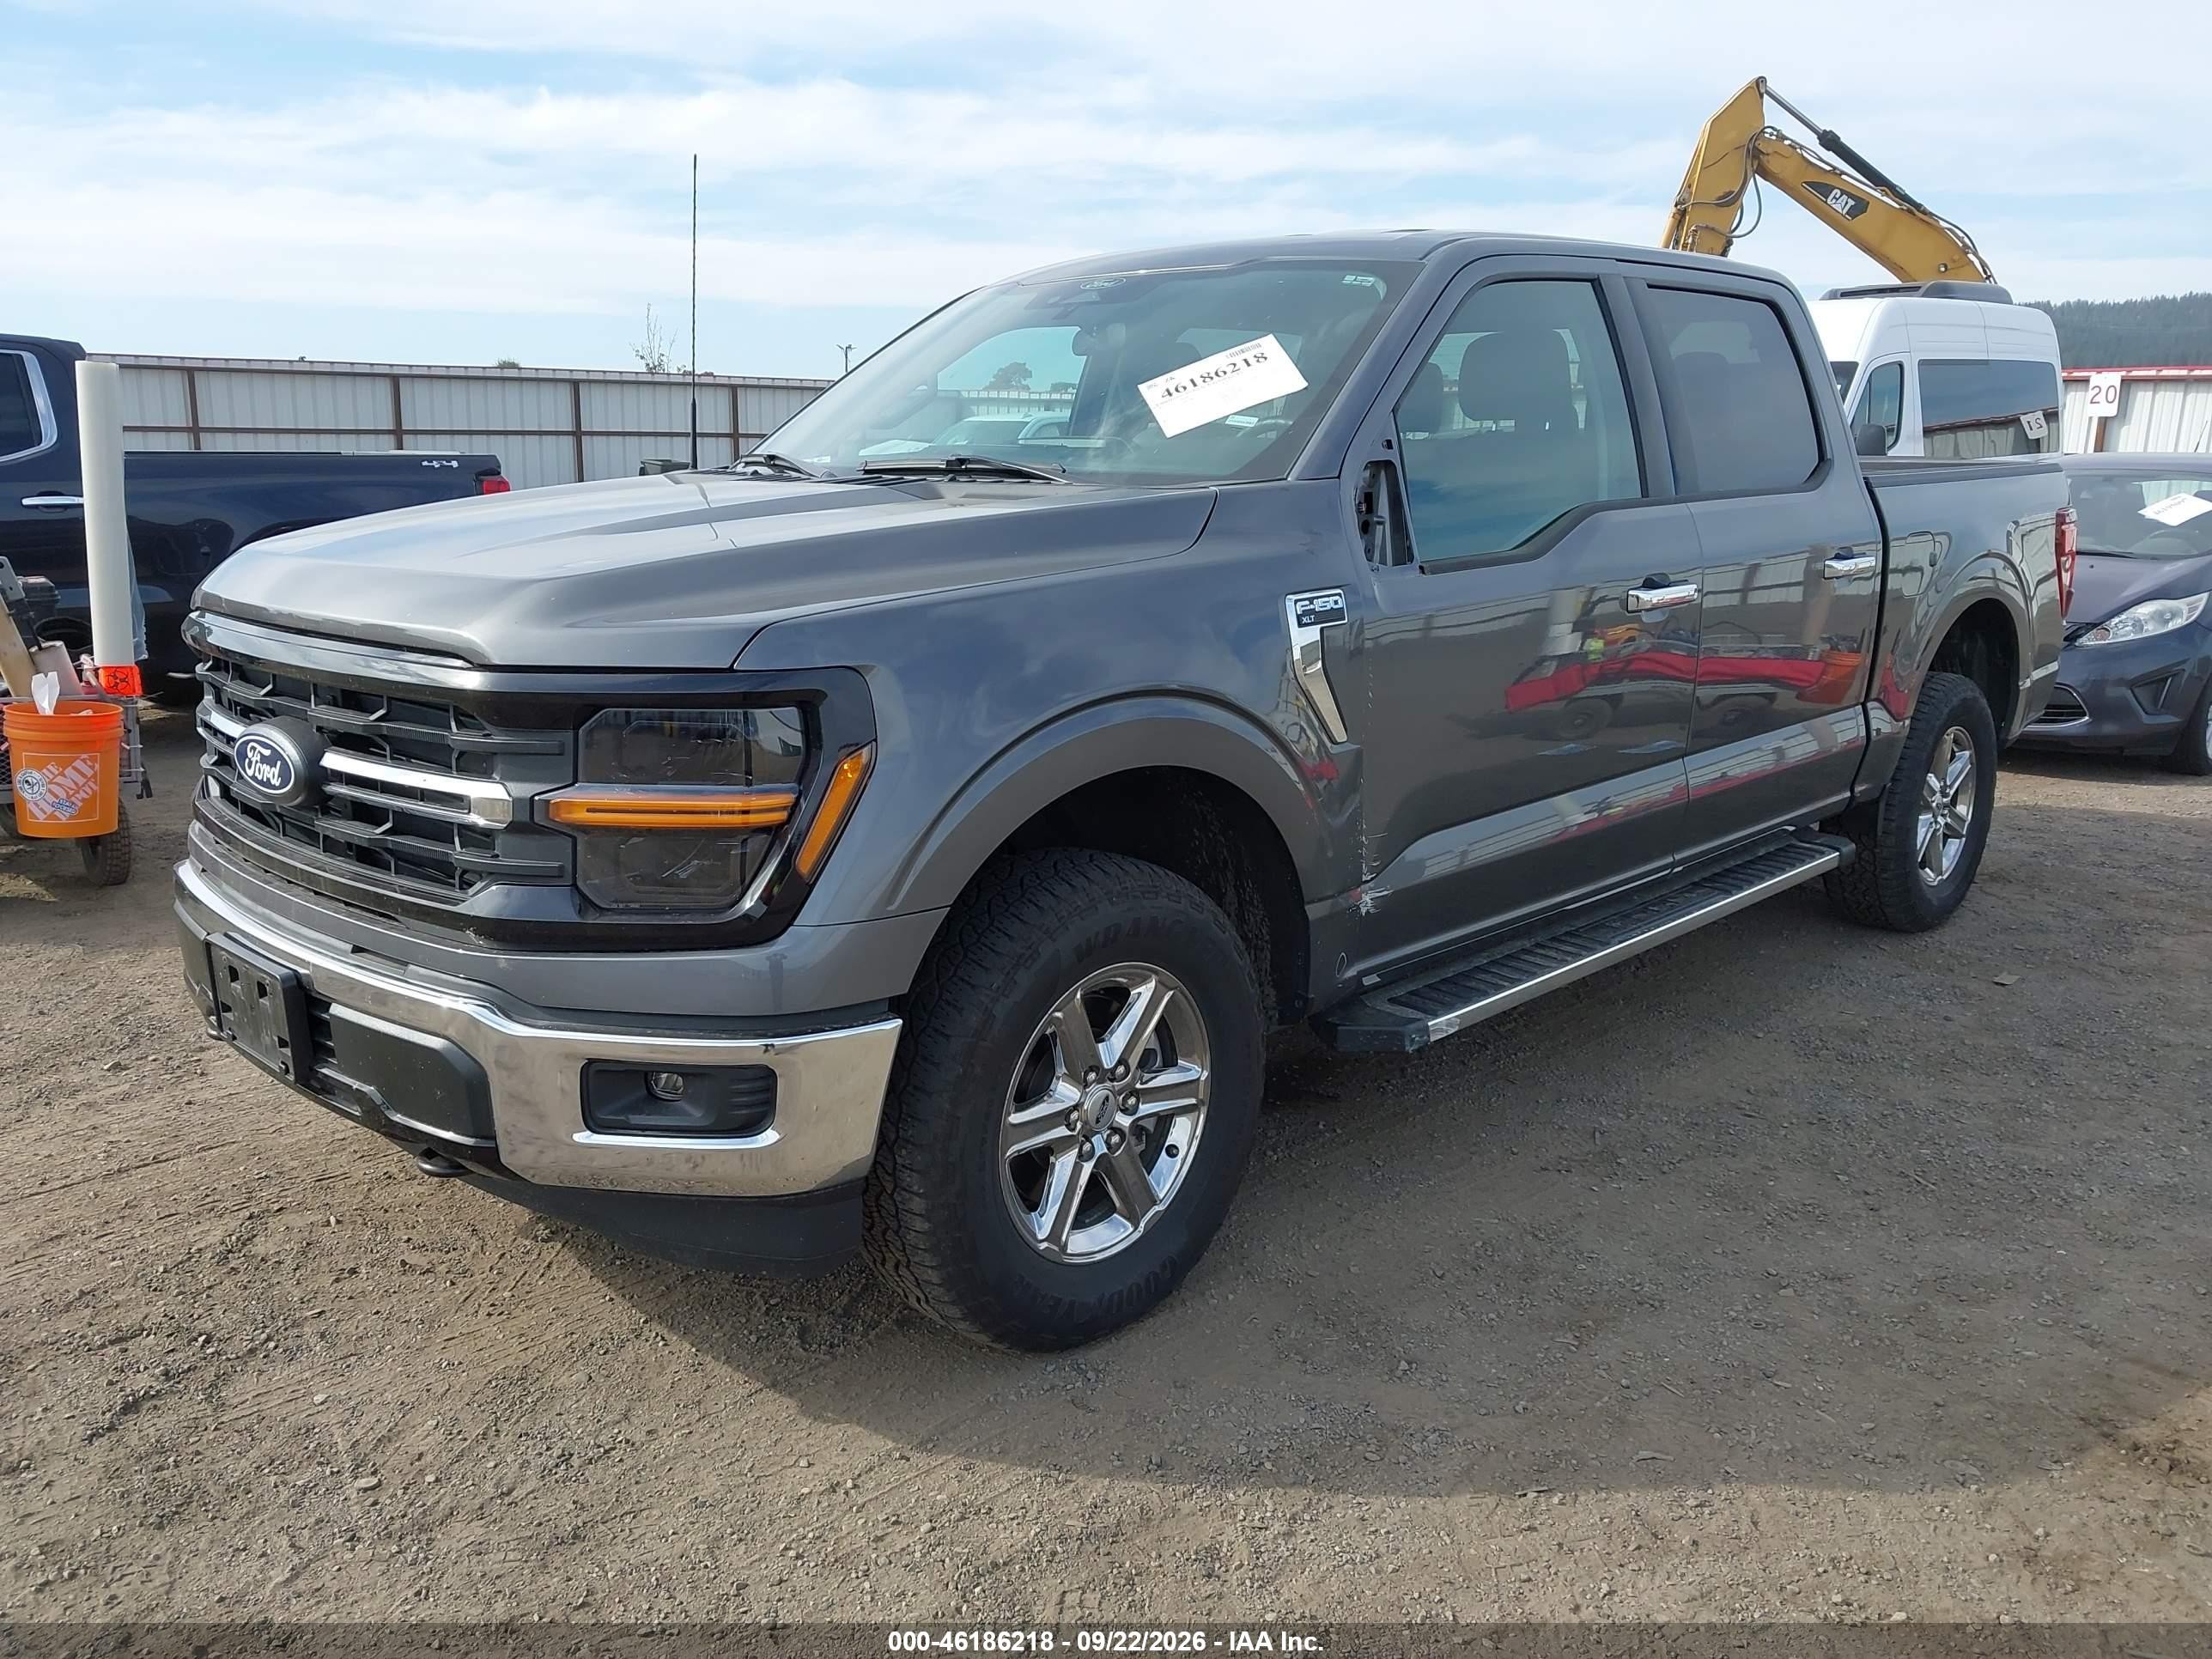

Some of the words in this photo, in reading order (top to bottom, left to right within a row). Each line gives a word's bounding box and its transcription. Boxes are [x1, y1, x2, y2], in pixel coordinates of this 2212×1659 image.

[1826, 188, 1856, 216] CAT
[1161, 352, 1268, 398] 46186218
[2090, 385, 2117, 404] 20
[1296, 596, 1344, 614] F-150
[245, 742, 282, 787] Ford
[27, 755, 98, 820] HOME
